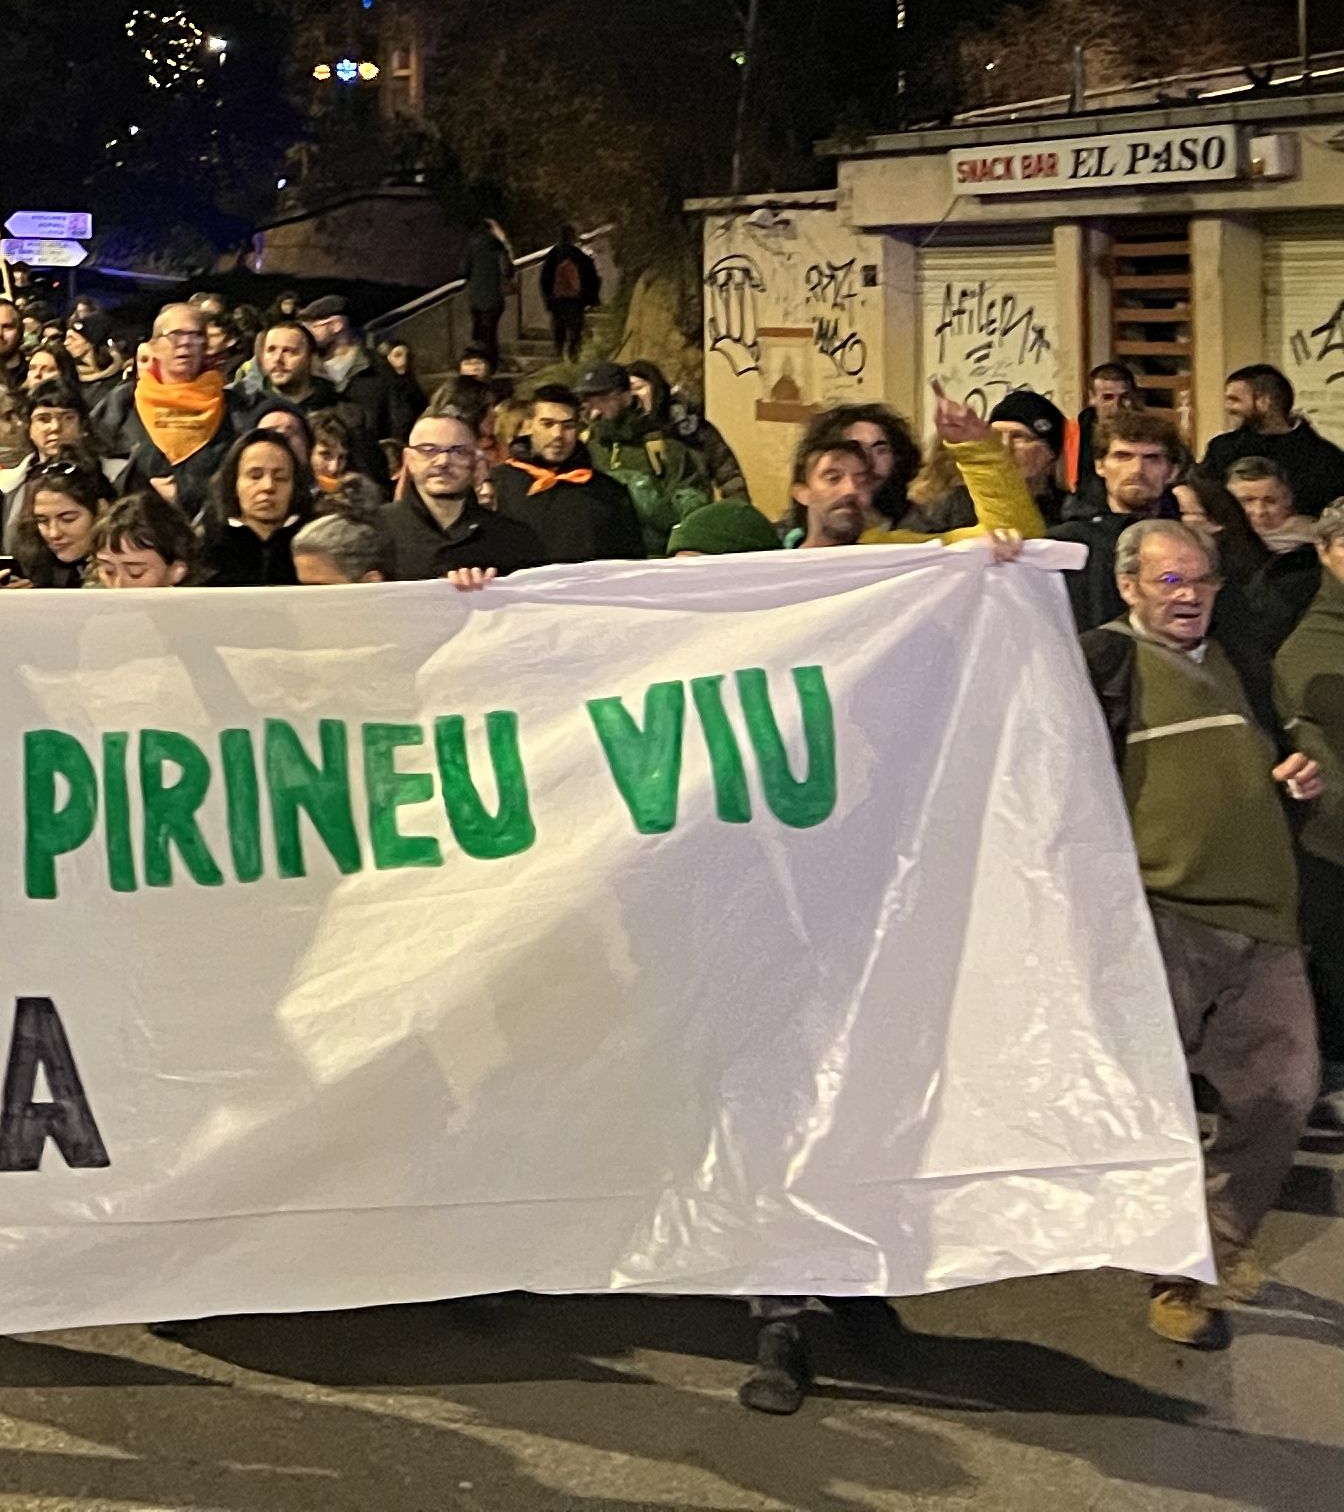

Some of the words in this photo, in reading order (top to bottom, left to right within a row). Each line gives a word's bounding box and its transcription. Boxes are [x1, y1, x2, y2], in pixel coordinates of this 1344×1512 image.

[956, 155, 1015, 184] SNACK
[1020, 152, 1059, 179] BAR
[1067, 145, 1117, 179] EL
[1123, 135, 1226, 177] PASO
[22, 709, 536, 900] PIRINEU
[586, 664, 838, 835] VIU
